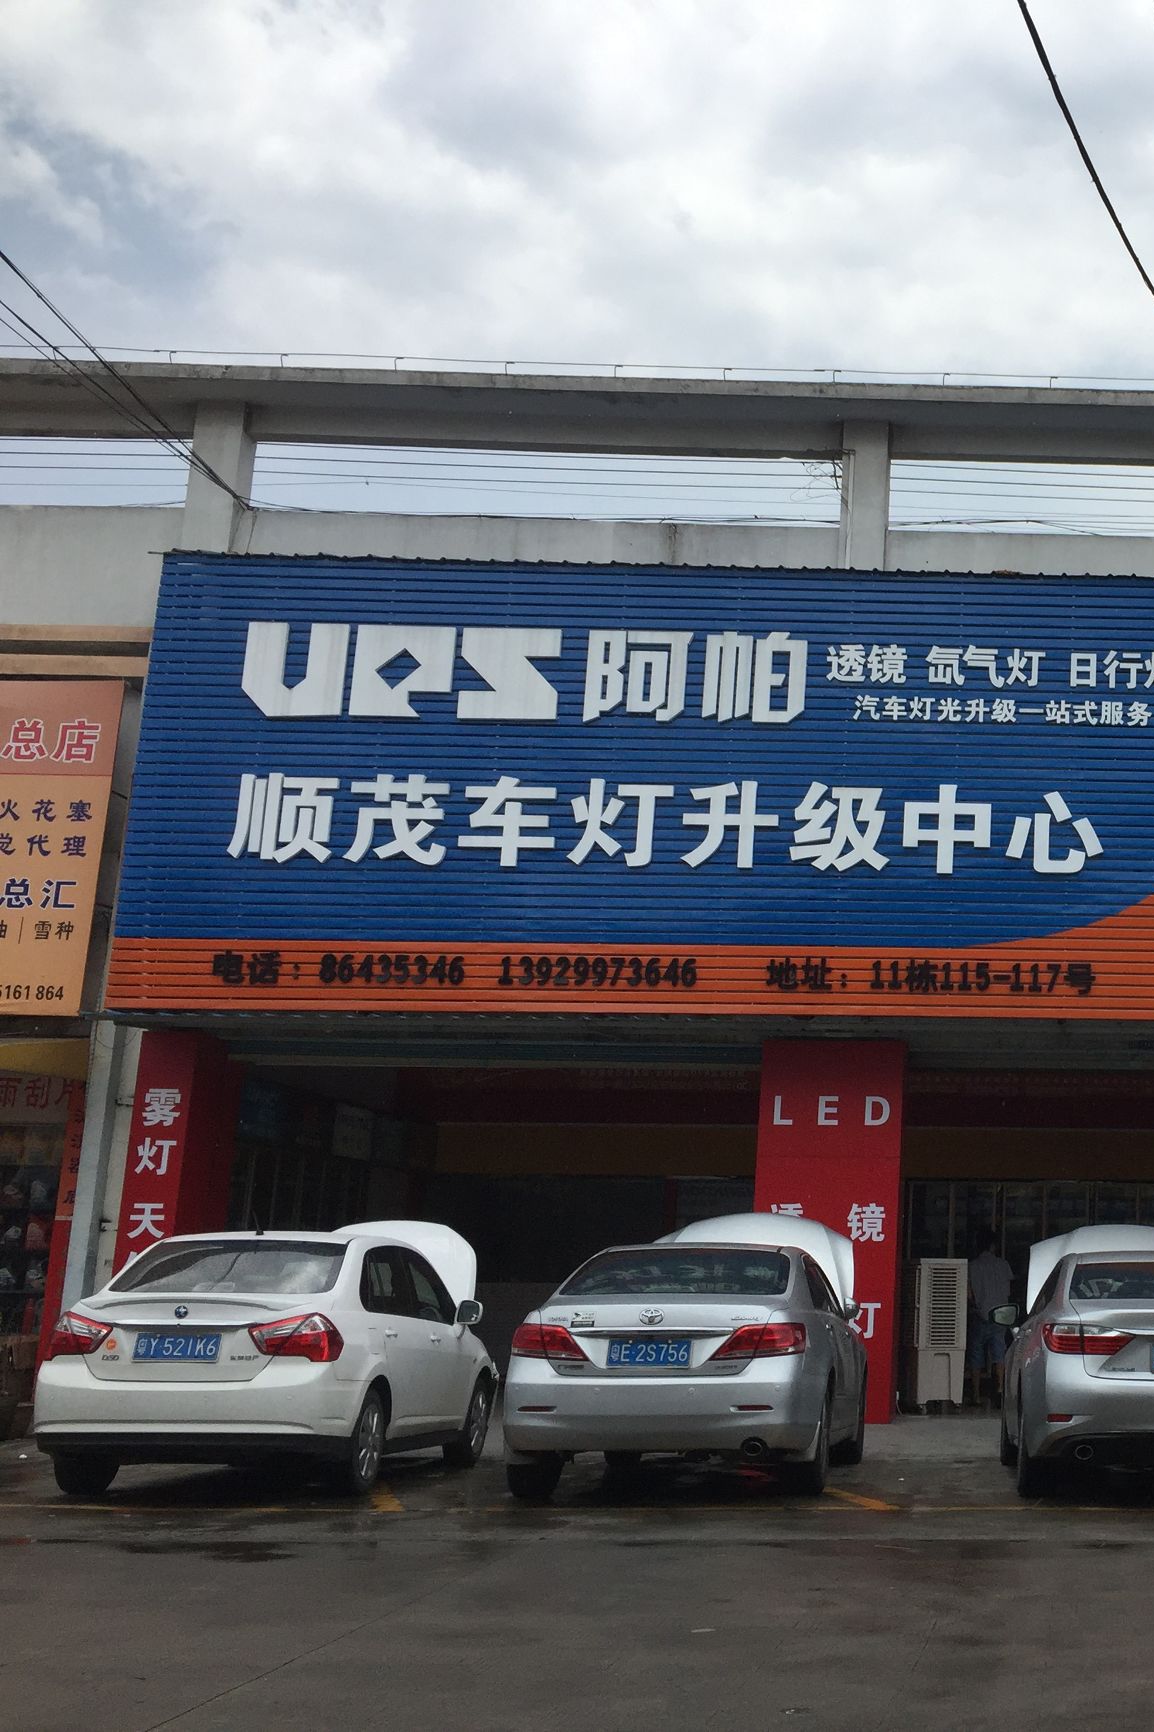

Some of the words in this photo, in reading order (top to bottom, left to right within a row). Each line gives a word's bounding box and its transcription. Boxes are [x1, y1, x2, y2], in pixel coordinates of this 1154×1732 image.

[582, 630, 808, 724] 阿帕
[826, 644, 907, 684] 透镜
[926, 645, 1047, 688] 氙气灯
[852, 694, 1153, 727] 汽车灯光升级一站式服务
[2, 719, 101, 764] 总店
[227, 772, 1104, 875] 顺茂车灯升级中心
[319, 954, 465, 985] 86435346
[500, 955, 697, 987] 13929973646
[772, 1095, 891, 1126] LED
